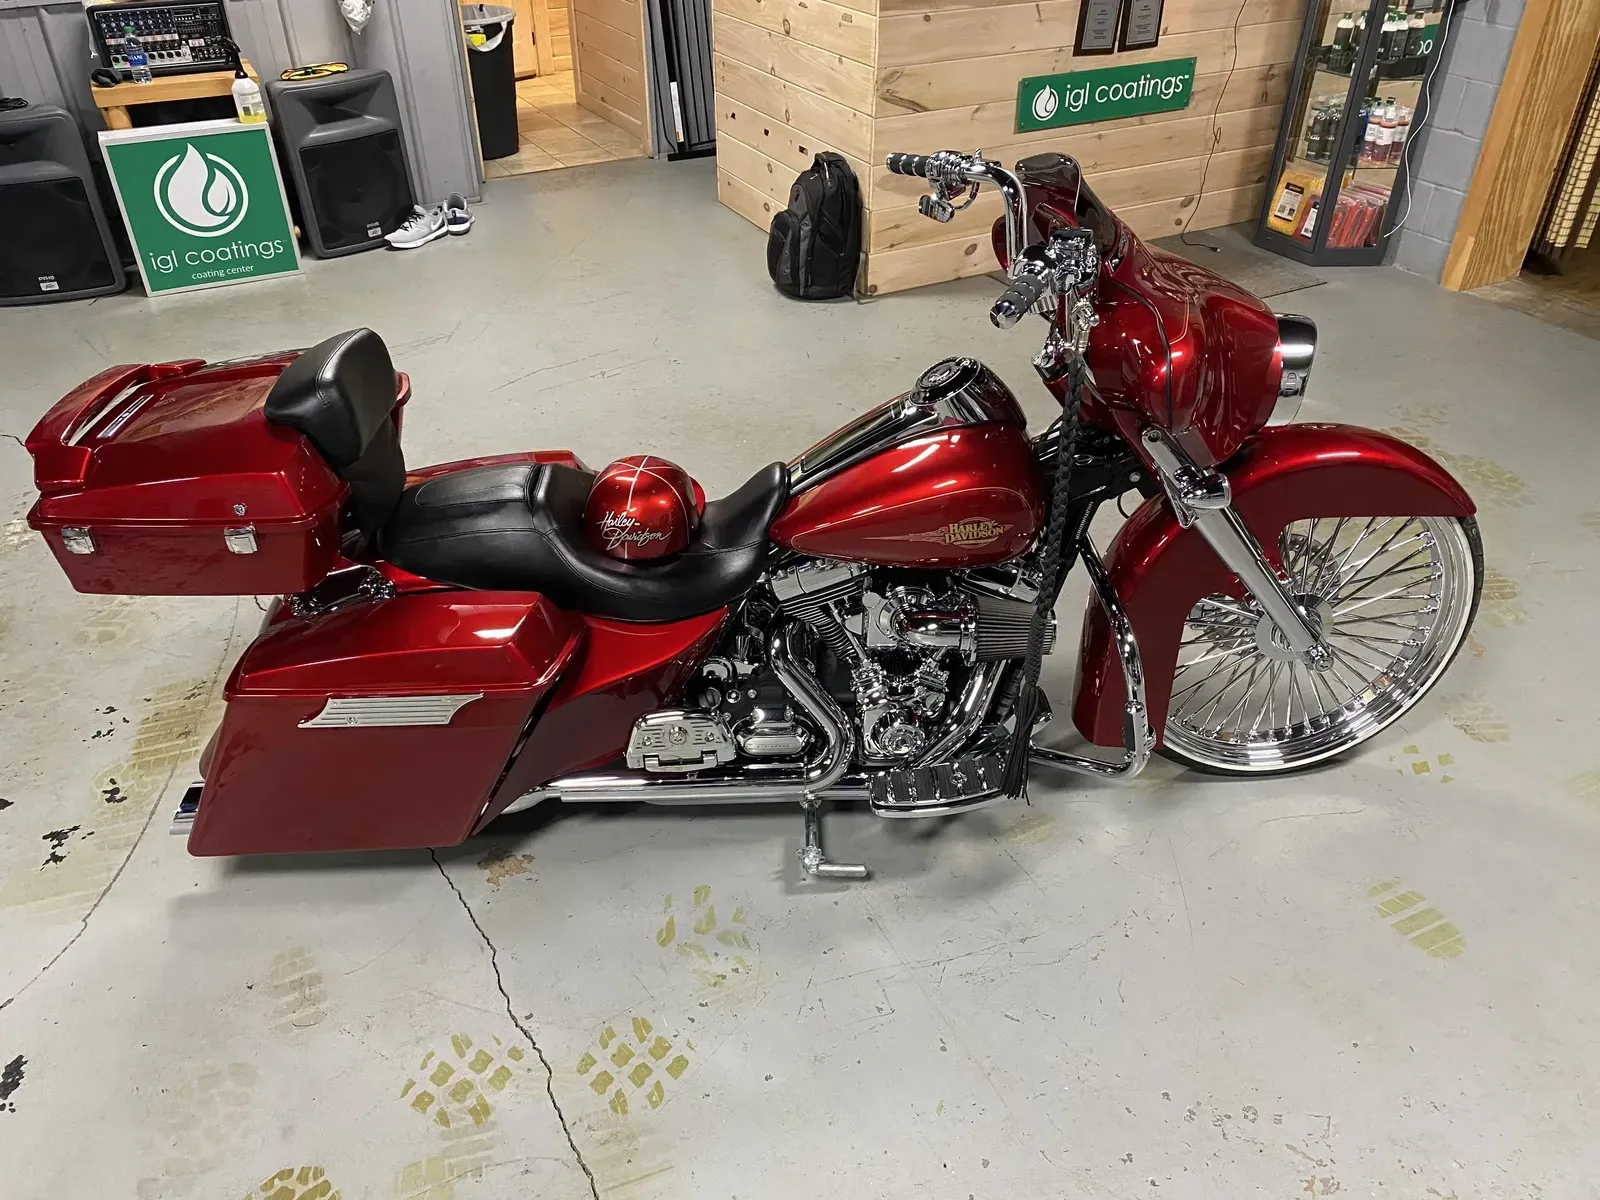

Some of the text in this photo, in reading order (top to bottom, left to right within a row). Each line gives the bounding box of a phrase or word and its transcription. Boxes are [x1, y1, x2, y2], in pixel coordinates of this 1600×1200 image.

[1065, 82, 1090, 112] igl
[149, 240, 284, 273] igl coatings
[191, 265, 254, 280] coating center
[601, 527, 673, 551] Davidson
[944, 526, 1004, 544] DAVIDSON
